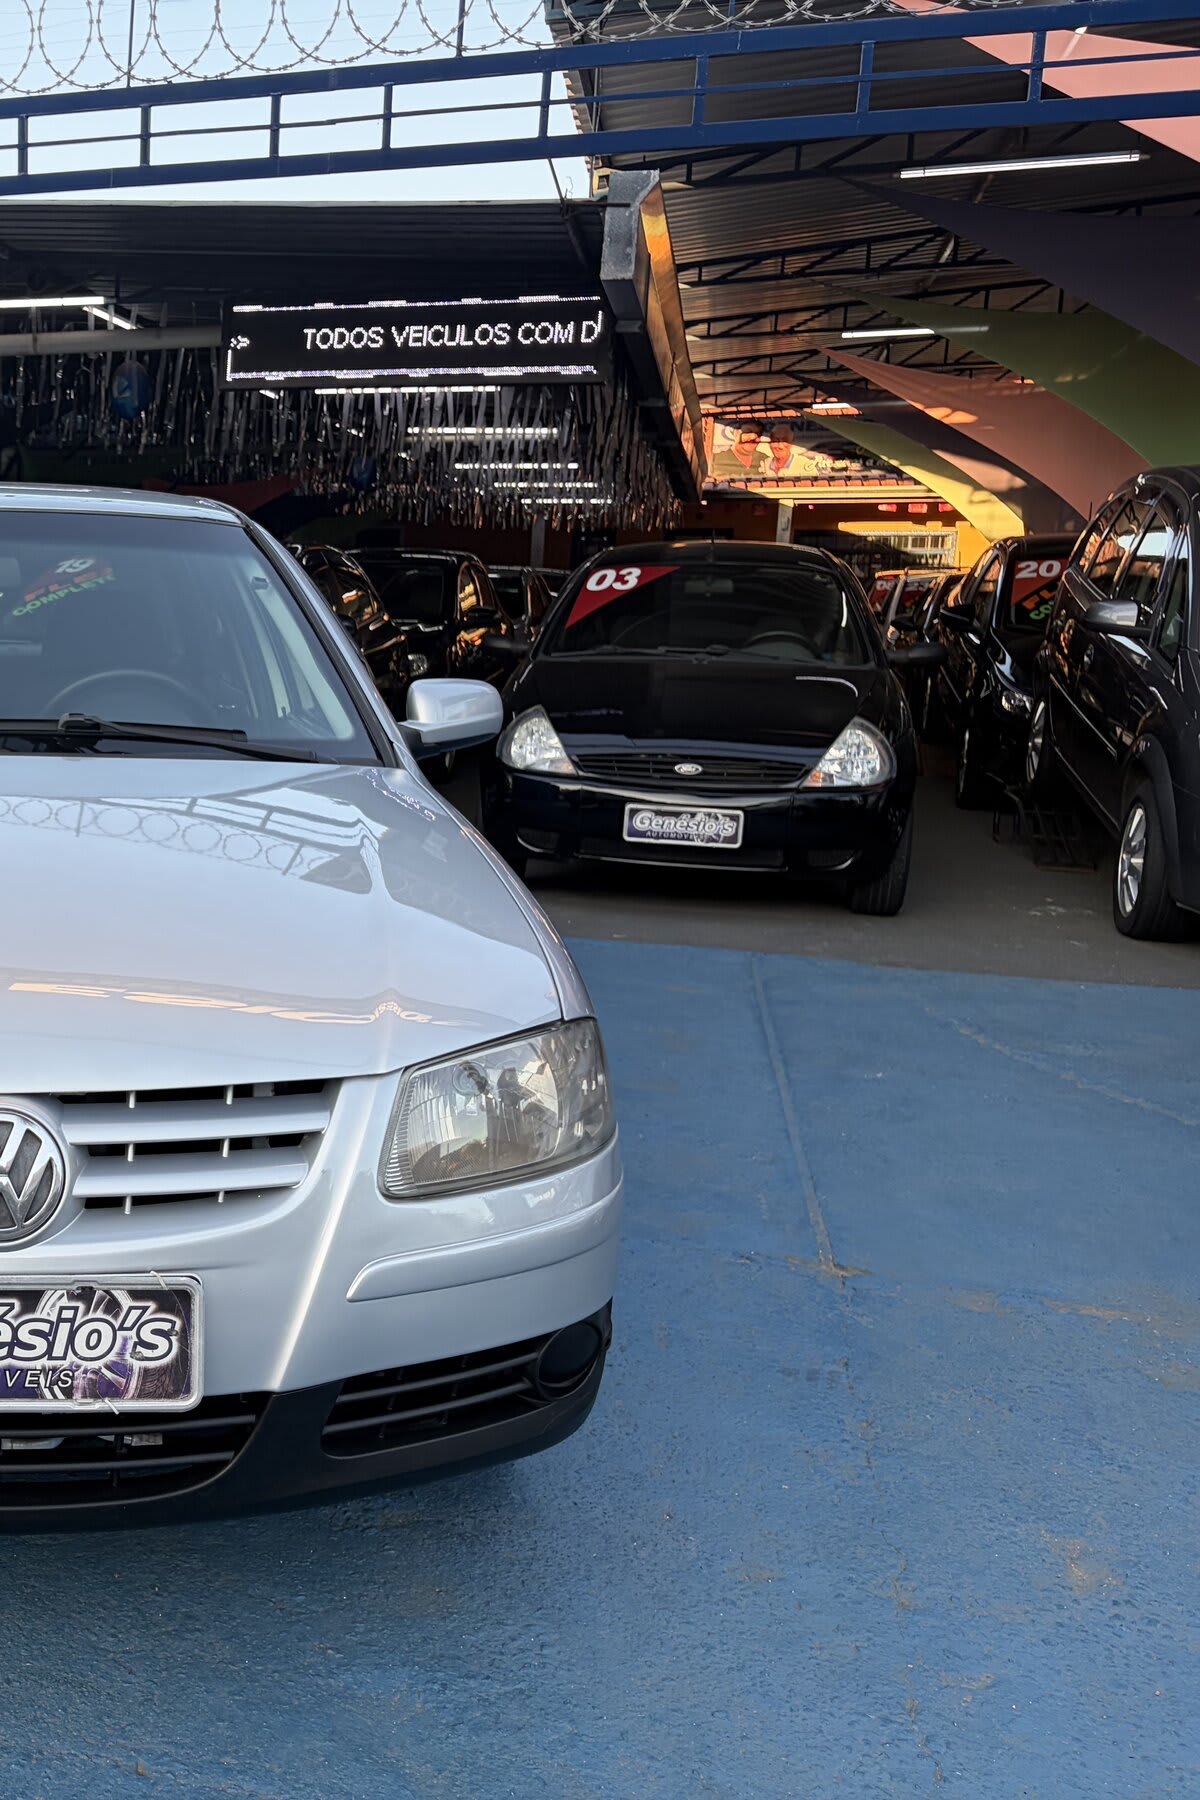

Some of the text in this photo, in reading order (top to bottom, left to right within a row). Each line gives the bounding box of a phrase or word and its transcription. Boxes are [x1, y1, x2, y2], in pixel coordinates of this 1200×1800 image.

[303, 327, 384, 350] TODOS
[391, 322, 511, 347] VEICULOS
[517, 321, 574, 344] COM
[54, 558, 96, 574] 19
[1015, 560, 1062, 579] 20
[586, 567, 641, 592] 03
